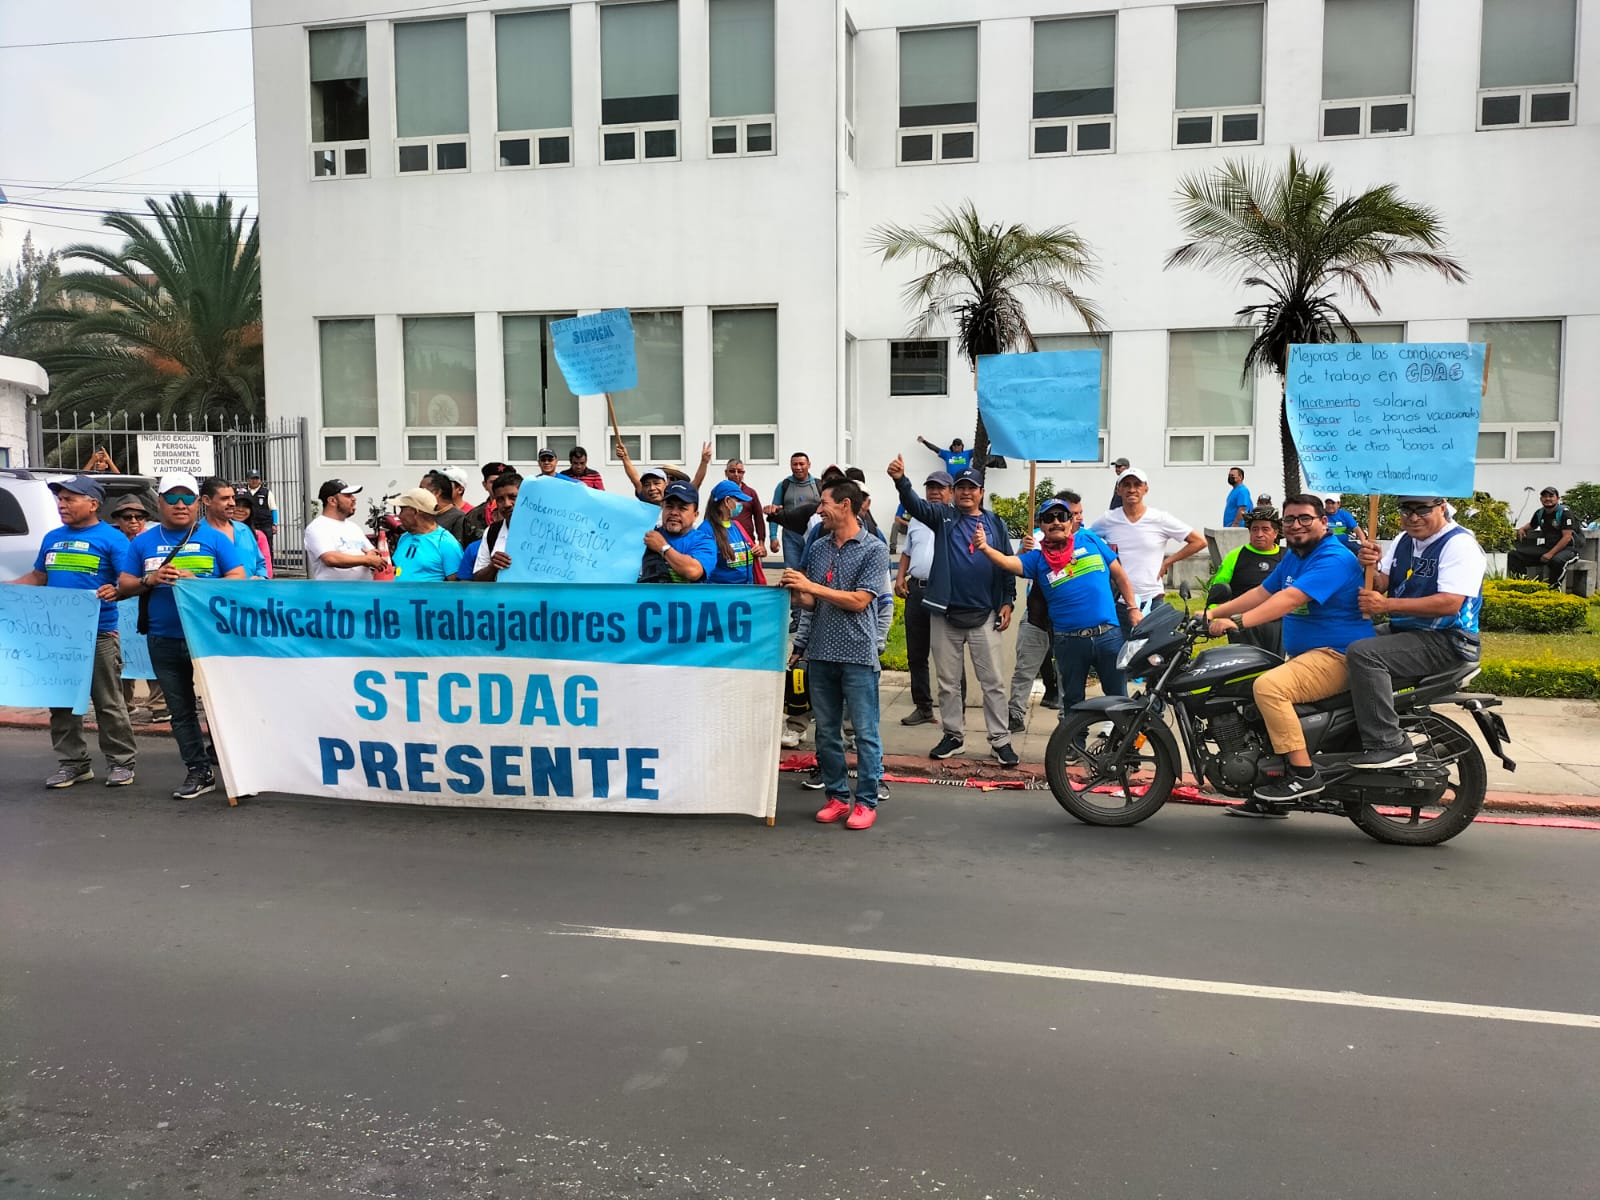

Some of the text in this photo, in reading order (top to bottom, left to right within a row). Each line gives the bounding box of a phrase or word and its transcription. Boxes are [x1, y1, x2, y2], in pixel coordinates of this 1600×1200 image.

[1291, 346, 1338, 368] Mejoras
[1346, 345, 1362, 361] de
[1371, 345, 1389, 361] las
[1298, 370, 1315, 385] de
[1324, 367, 1372, 385] trabajo
[1378, 370, 1398, 383] en
[1298, 391, 1427, 409] Incremento salarial
[1298, 412, 1342, 427] Mejorar
[1353, 410, 1373, 424] los
[1382, 412, 1421, 422] bonos
[1313, 428, 1340, 438] bono
[1347, 427, 1363, 438] de
[153, 450, 201, 458] DEBIDAMENTE
[1345, 440, 1358, 451] de
[1364, 440, 1391, 451] otros
[1402, 438, 1435, 451] bonos
[1442, 437, 1455, 450] al
[1325, 467, 1341, 480] de
[1344, 465, 1373, 484] tiempo
[520, 496, 567, 518] Acabemos
[568, 512, 589, 525] con
[520, 540, 599, 569] en el Deporte
[1413, 557, 1437, 578] 25
[0, 608, 72, 640] raslados
[208, 595, 752, 651] Sindicato de Trabajadores CDAG
[353, 669, 599, 727] STCDAG
[318, 736, 659, 800] PRESENTE
